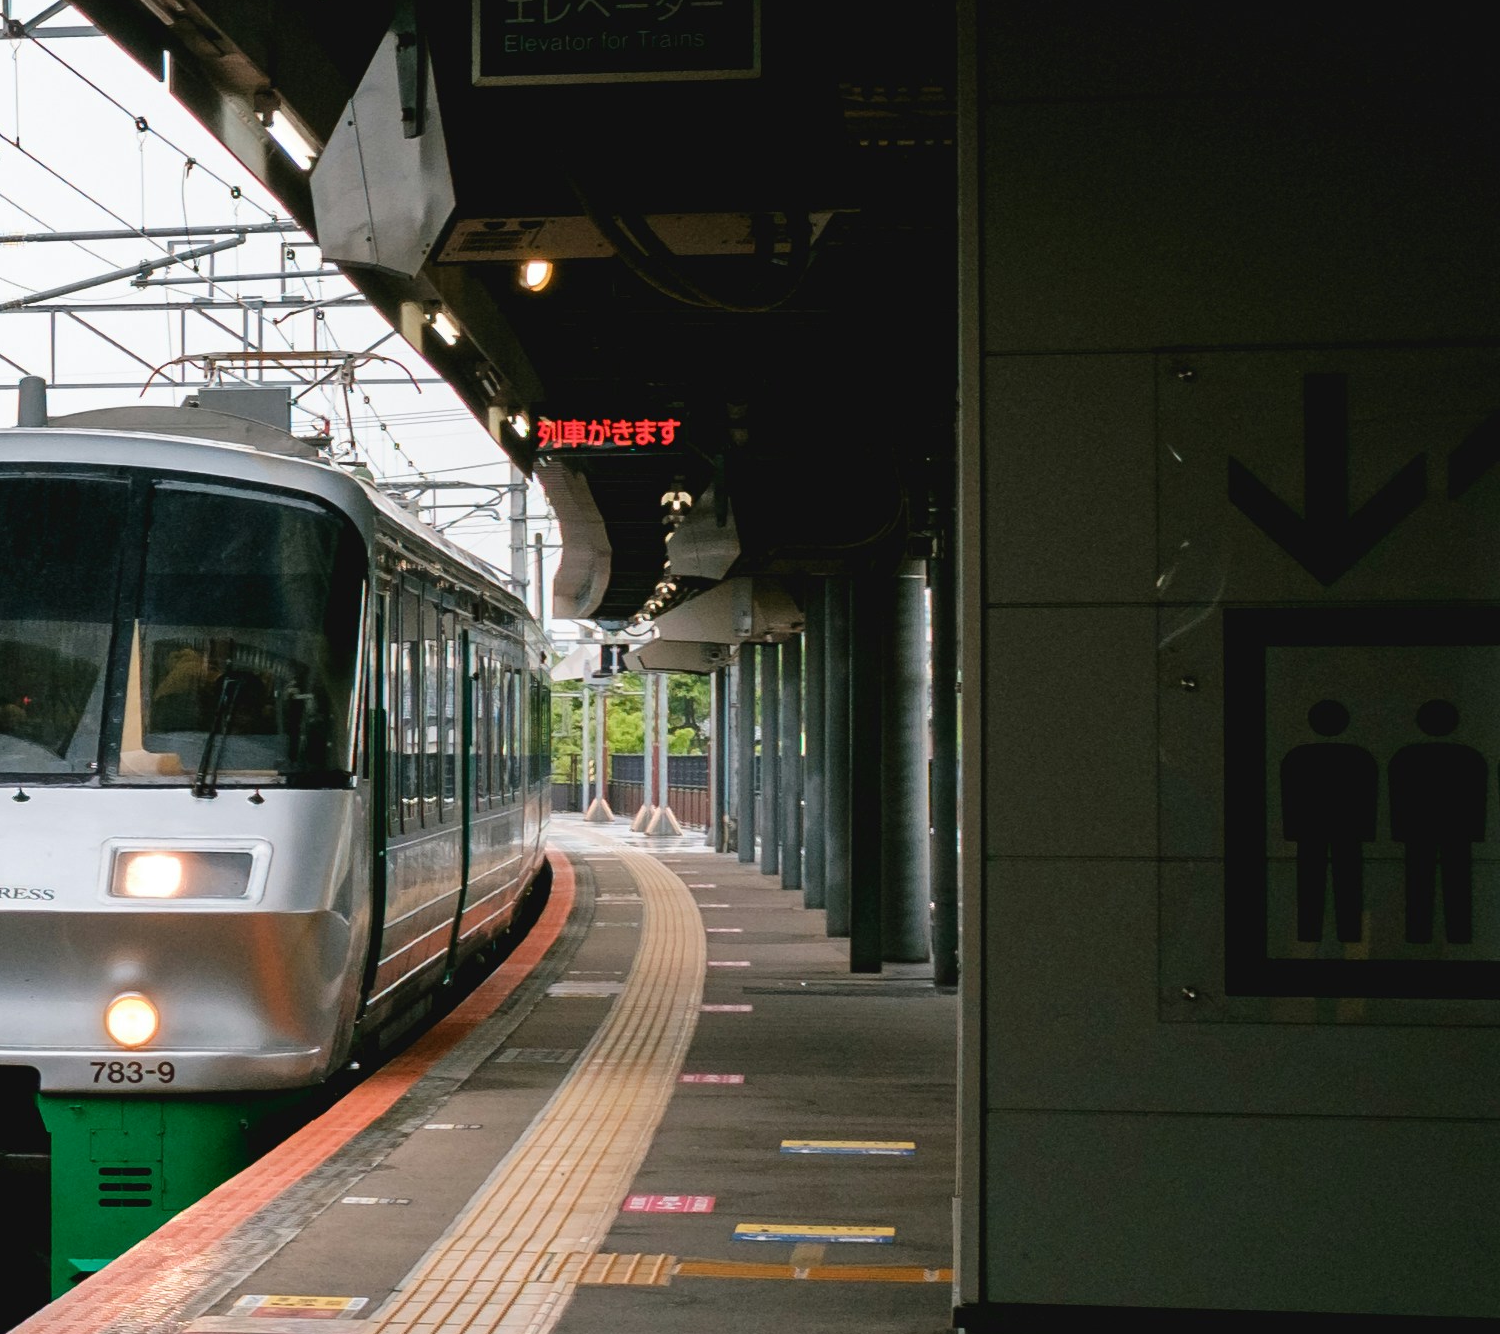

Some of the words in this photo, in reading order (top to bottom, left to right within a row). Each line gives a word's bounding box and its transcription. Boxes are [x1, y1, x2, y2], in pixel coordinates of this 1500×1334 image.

[504, 33, 595, 53] Elevator
[601, 32, 629, 50] for
[638, 30, 706, 49] Trains
[537, 417, 681, 449] 列車がきます
[90, 1061, 175, 1084] 783-9
